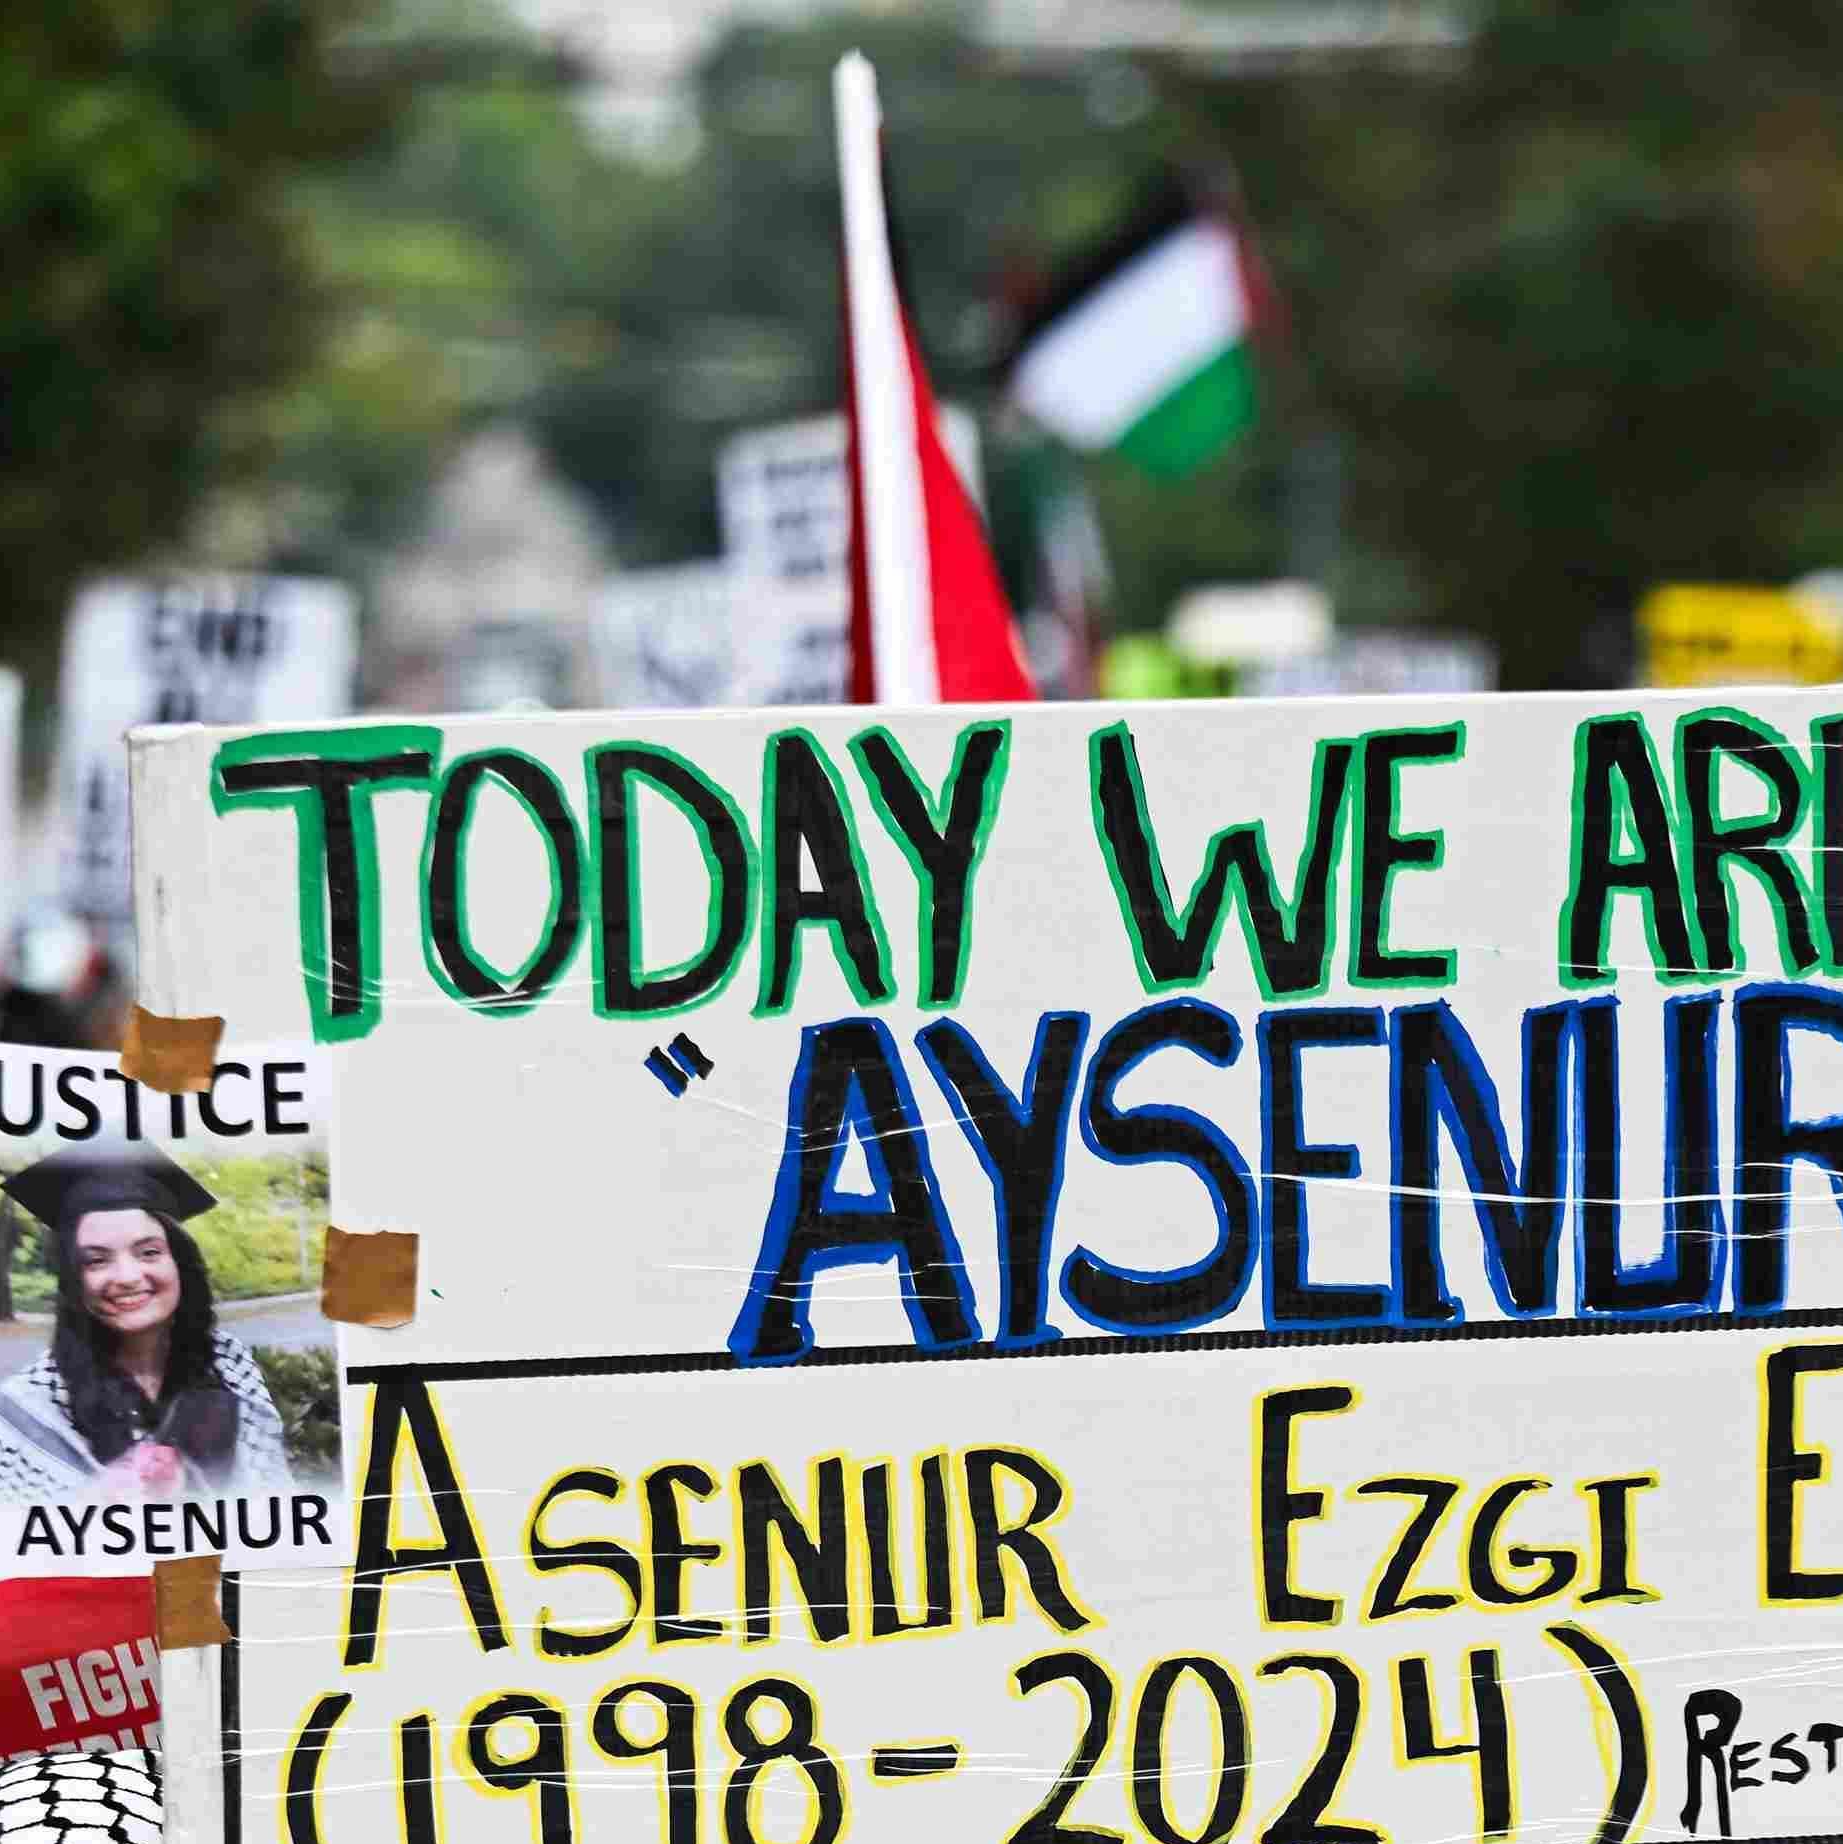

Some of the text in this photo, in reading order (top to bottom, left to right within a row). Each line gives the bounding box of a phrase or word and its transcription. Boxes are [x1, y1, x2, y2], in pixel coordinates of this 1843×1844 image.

[211, 718, 1011, 1045] TODAY
[1089, 719, 1465, 1002] WE
[17, 1494, 333, 1556] AYSENUR
[342, 1372, 1104, 1672] ASENUR
[1253, 1384, 1661, 1627] EZGI
